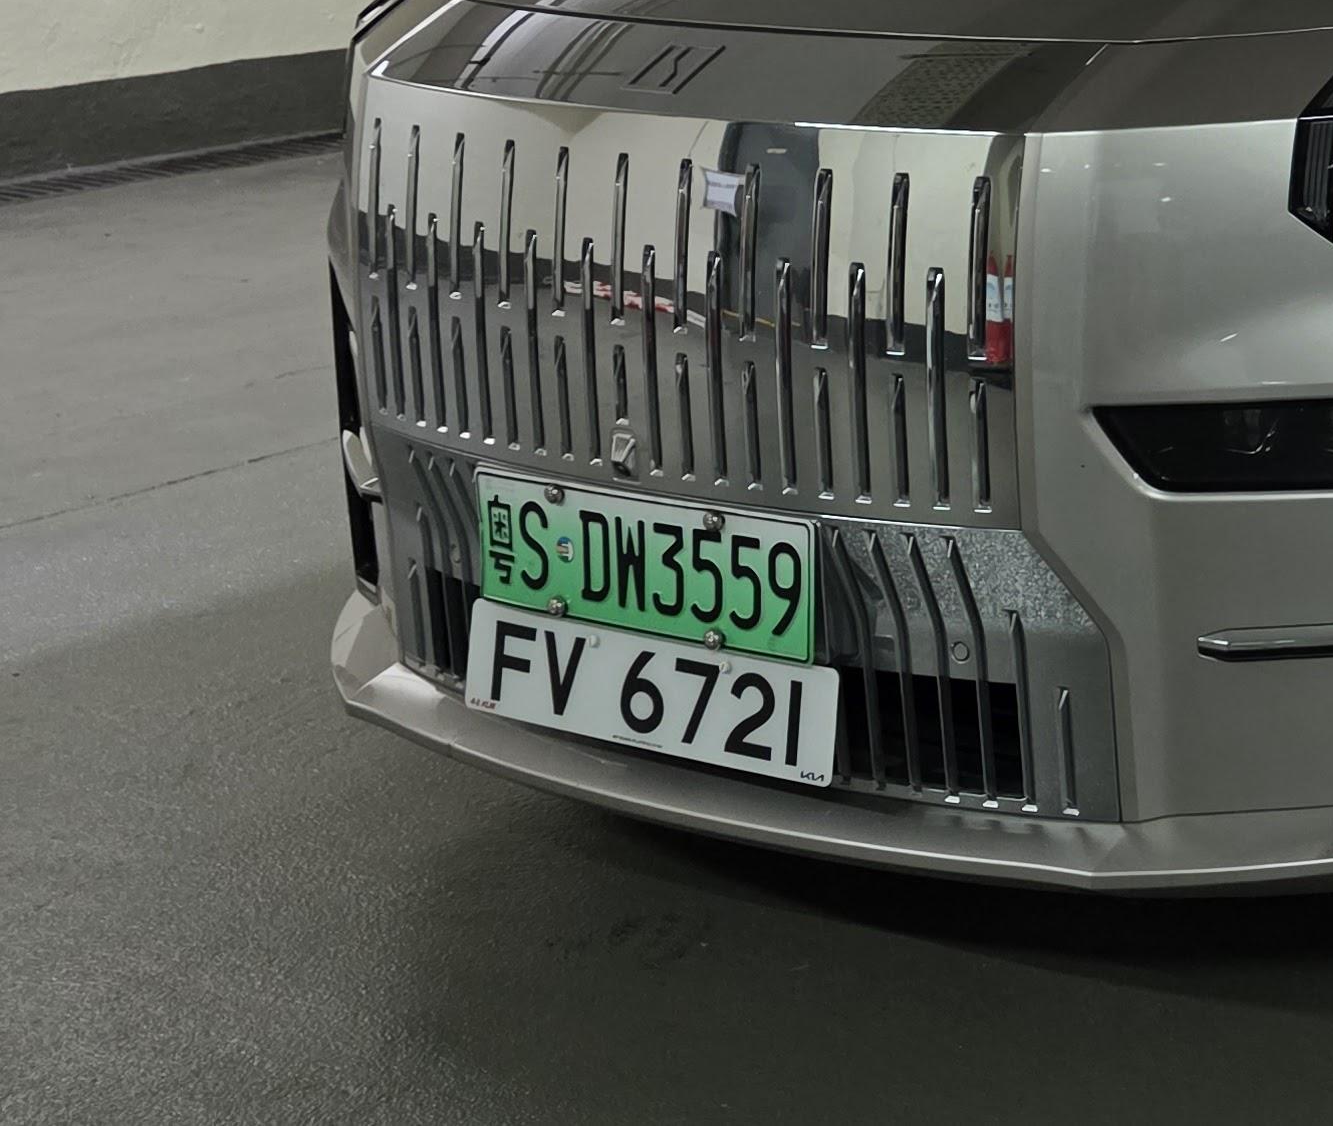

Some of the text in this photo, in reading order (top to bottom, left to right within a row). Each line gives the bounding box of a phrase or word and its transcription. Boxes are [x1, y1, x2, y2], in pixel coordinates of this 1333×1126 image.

[579, 508, 802, 637] DW3559
[490, 619, 803, 768] FV 6721
